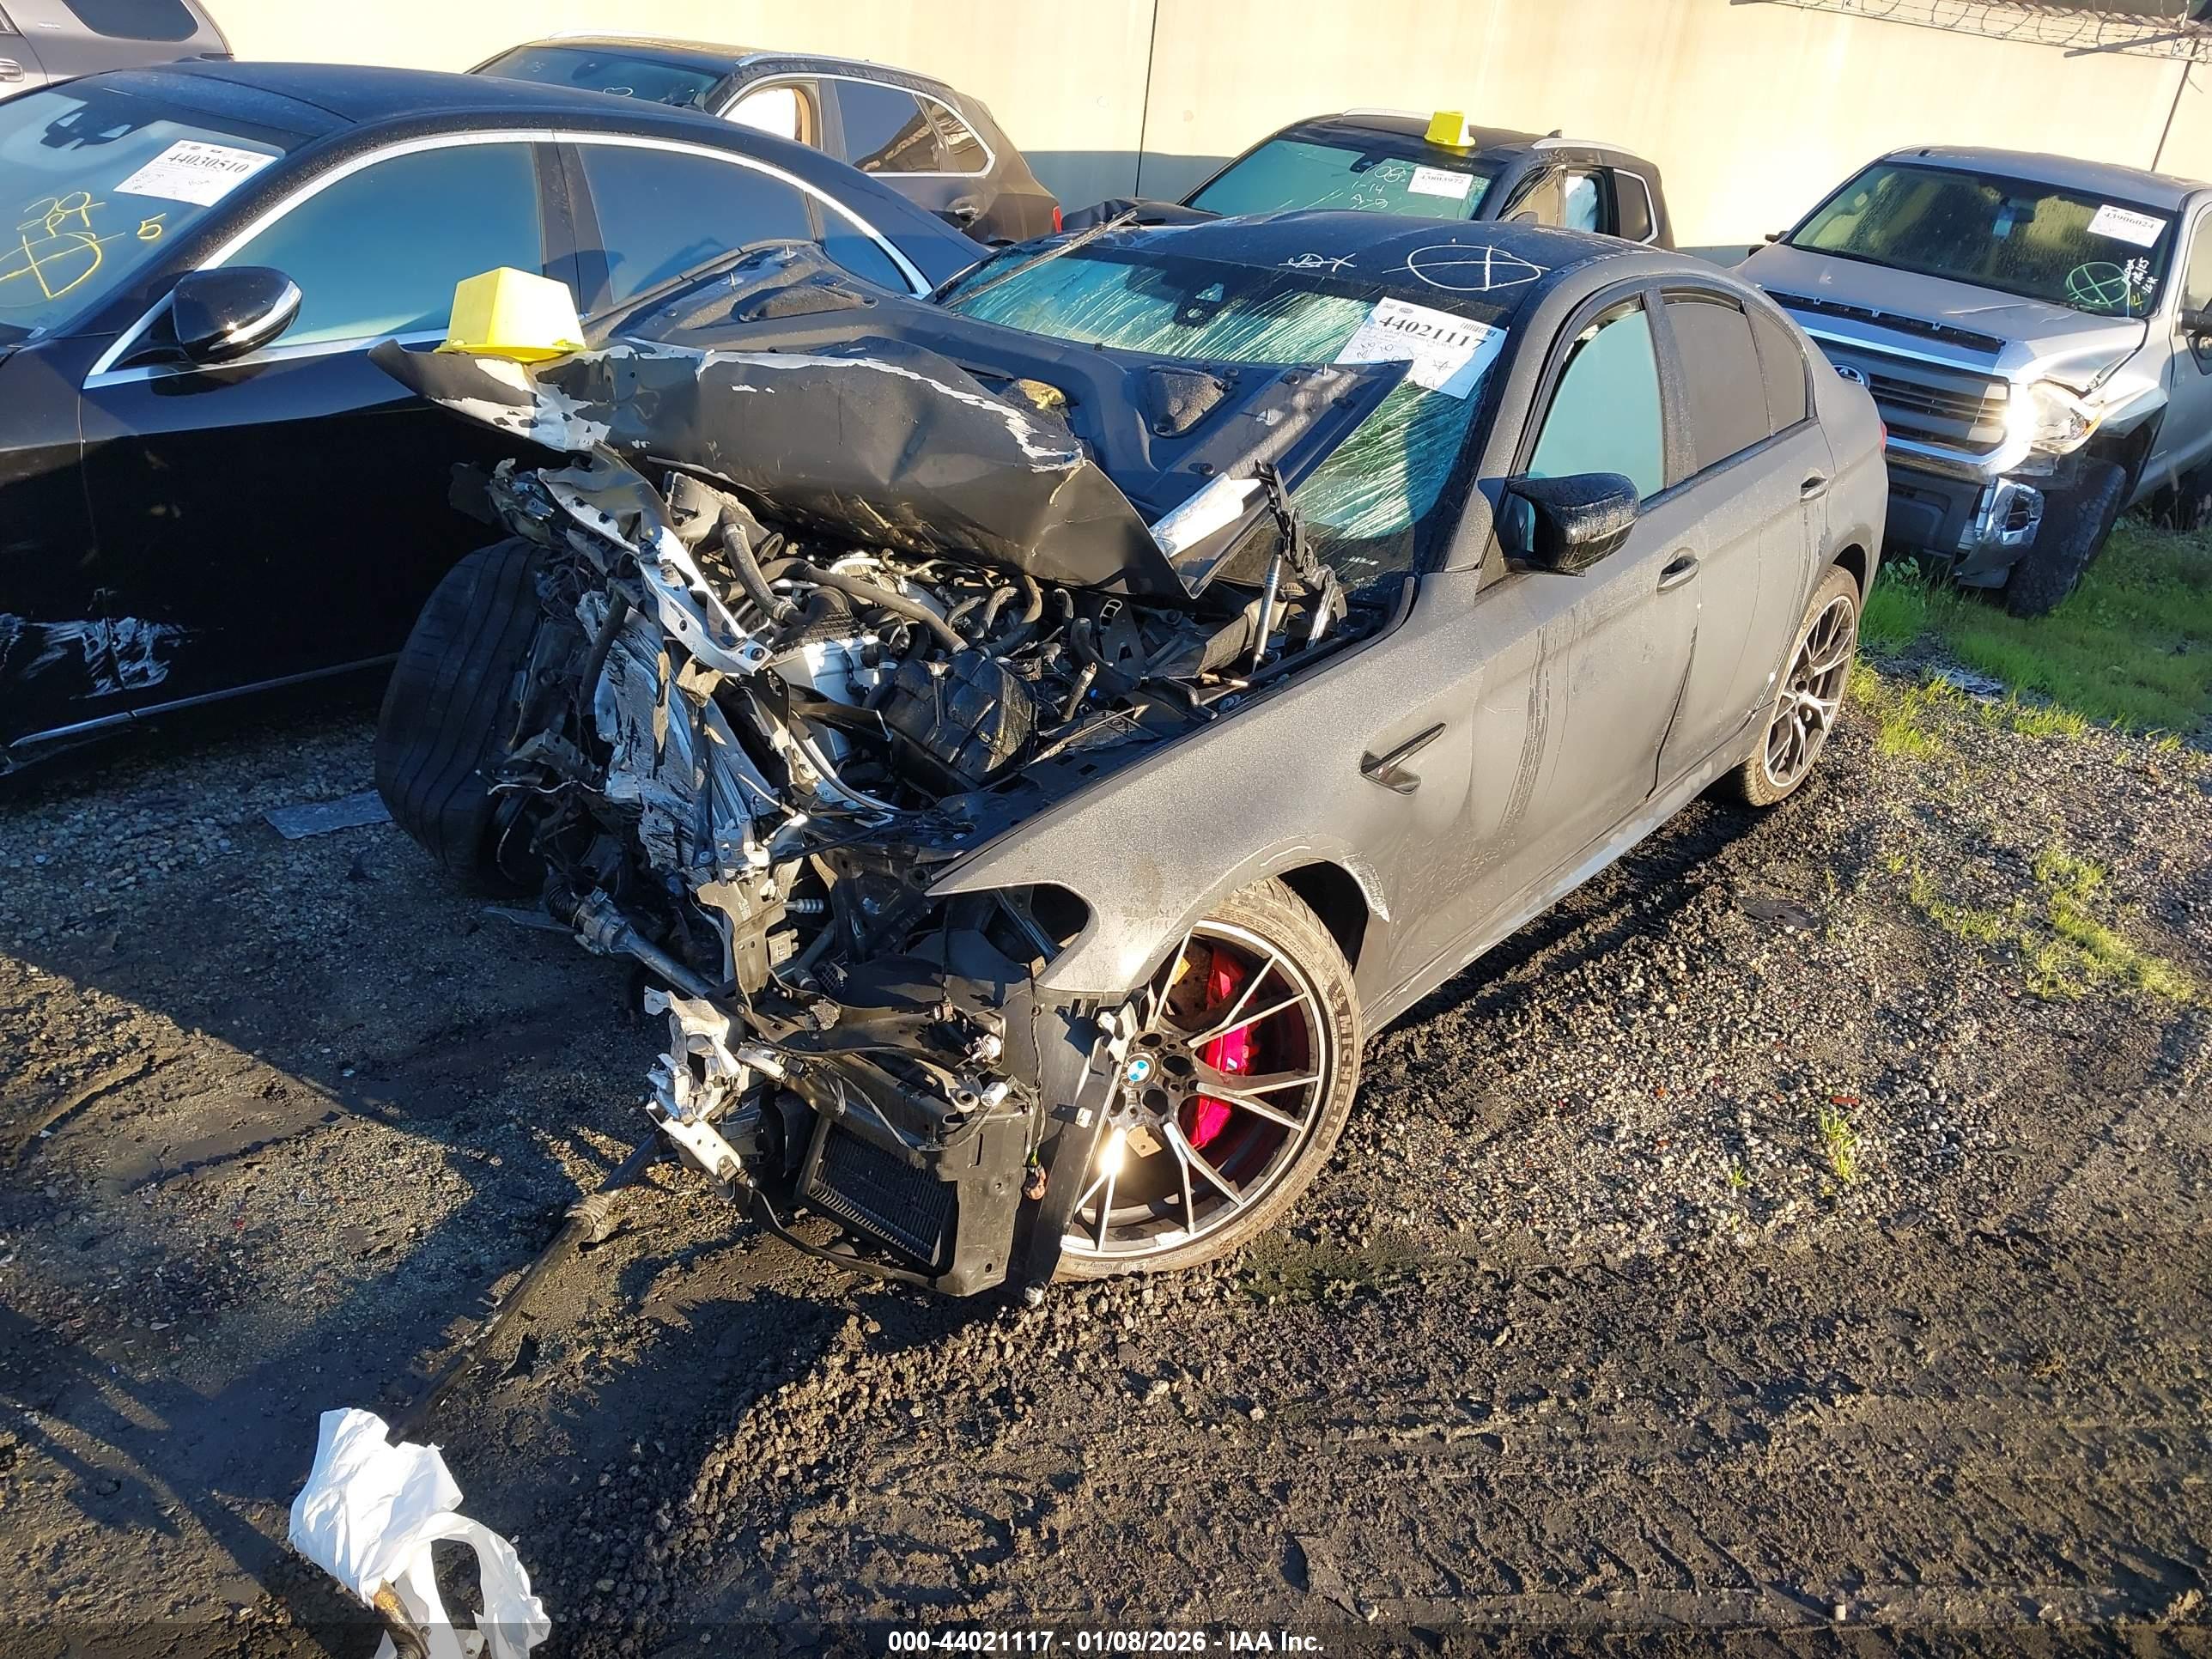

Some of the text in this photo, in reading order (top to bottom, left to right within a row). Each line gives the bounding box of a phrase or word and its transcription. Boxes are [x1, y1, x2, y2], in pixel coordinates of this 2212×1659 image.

[167, 153, 250, 173] 44030510
[137, 212, 167, 240] 5
[1378, 315, 1489, 350] 44021117
[1321, 1014, 1353, 1143] MICHELIN
